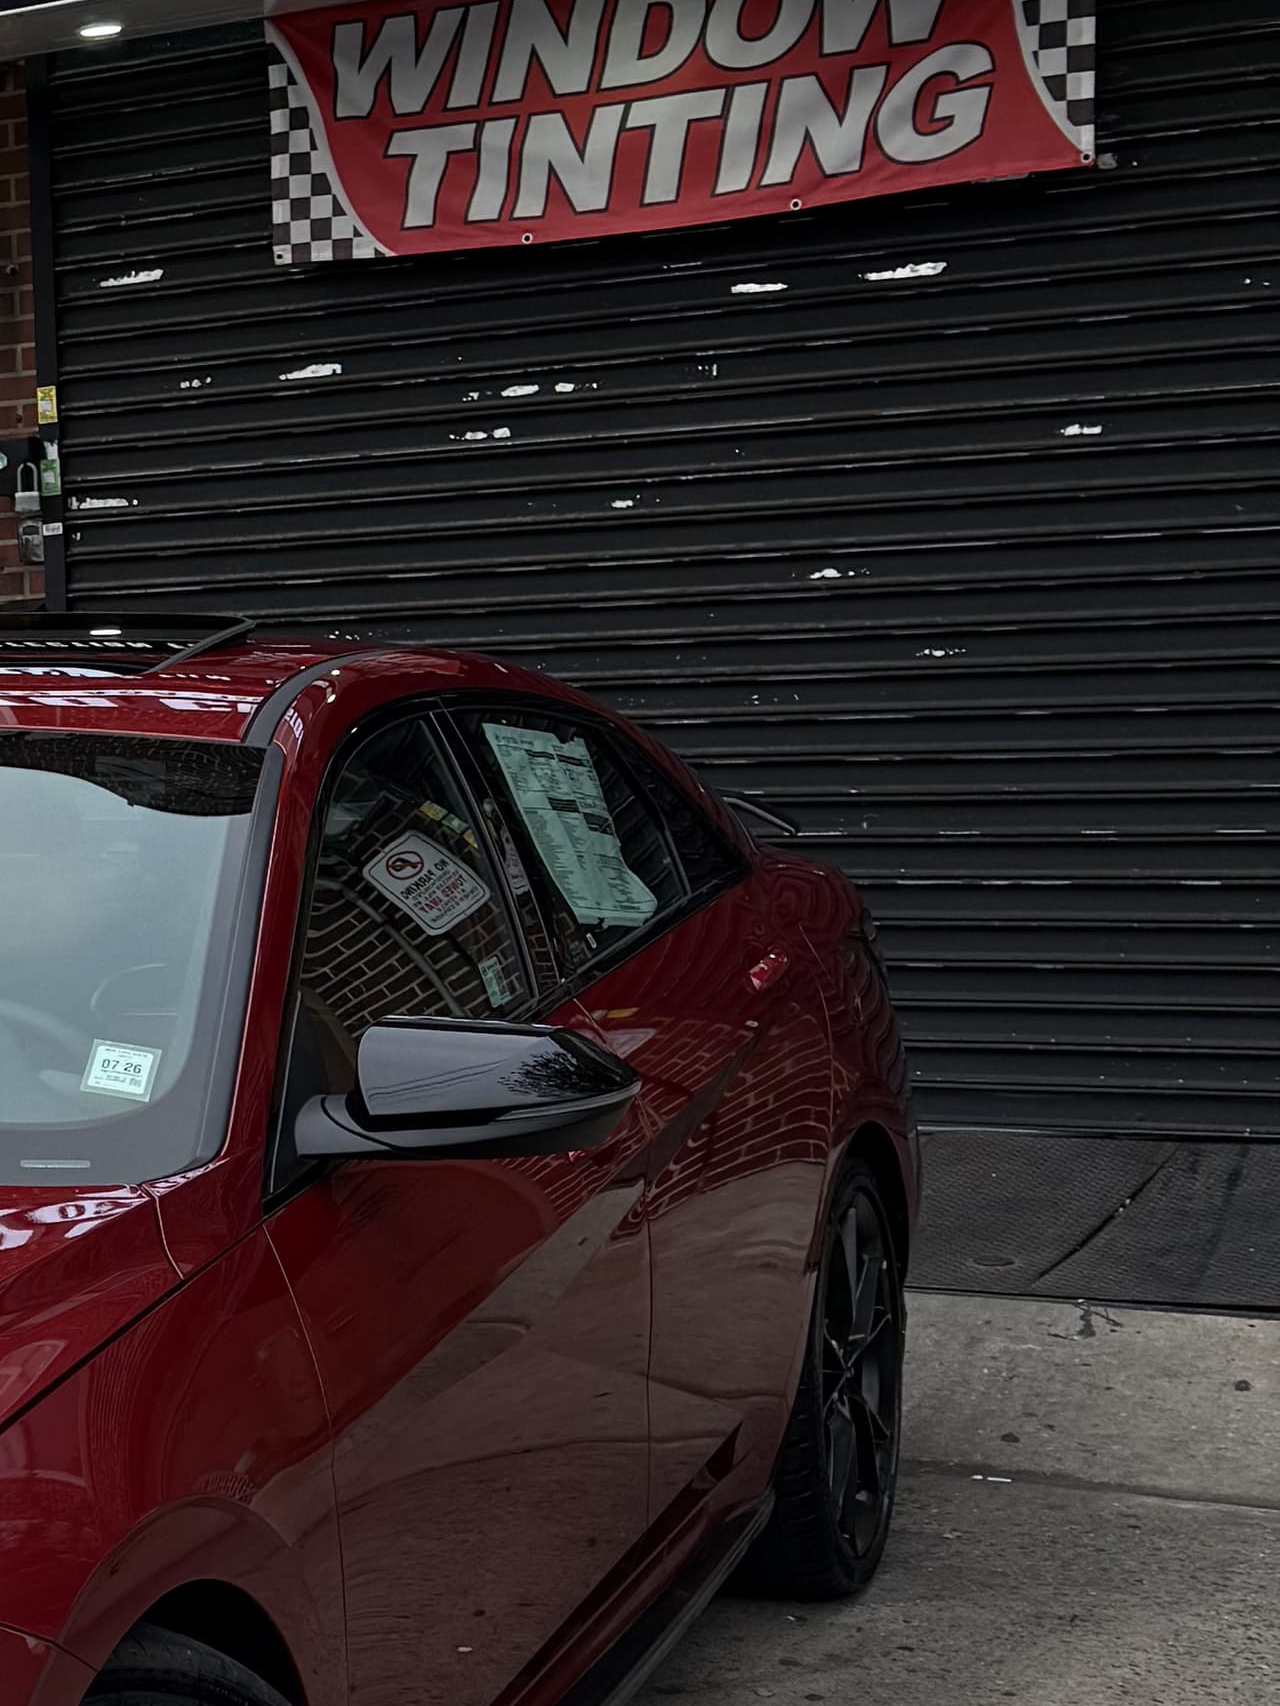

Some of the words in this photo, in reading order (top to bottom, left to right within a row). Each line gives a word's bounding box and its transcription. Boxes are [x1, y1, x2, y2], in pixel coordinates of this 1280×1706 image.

[382, 39, 996, 232] TINTING
[101, 1058, 120, 1070] 07
[124, 1062, 143, 1074] 26
